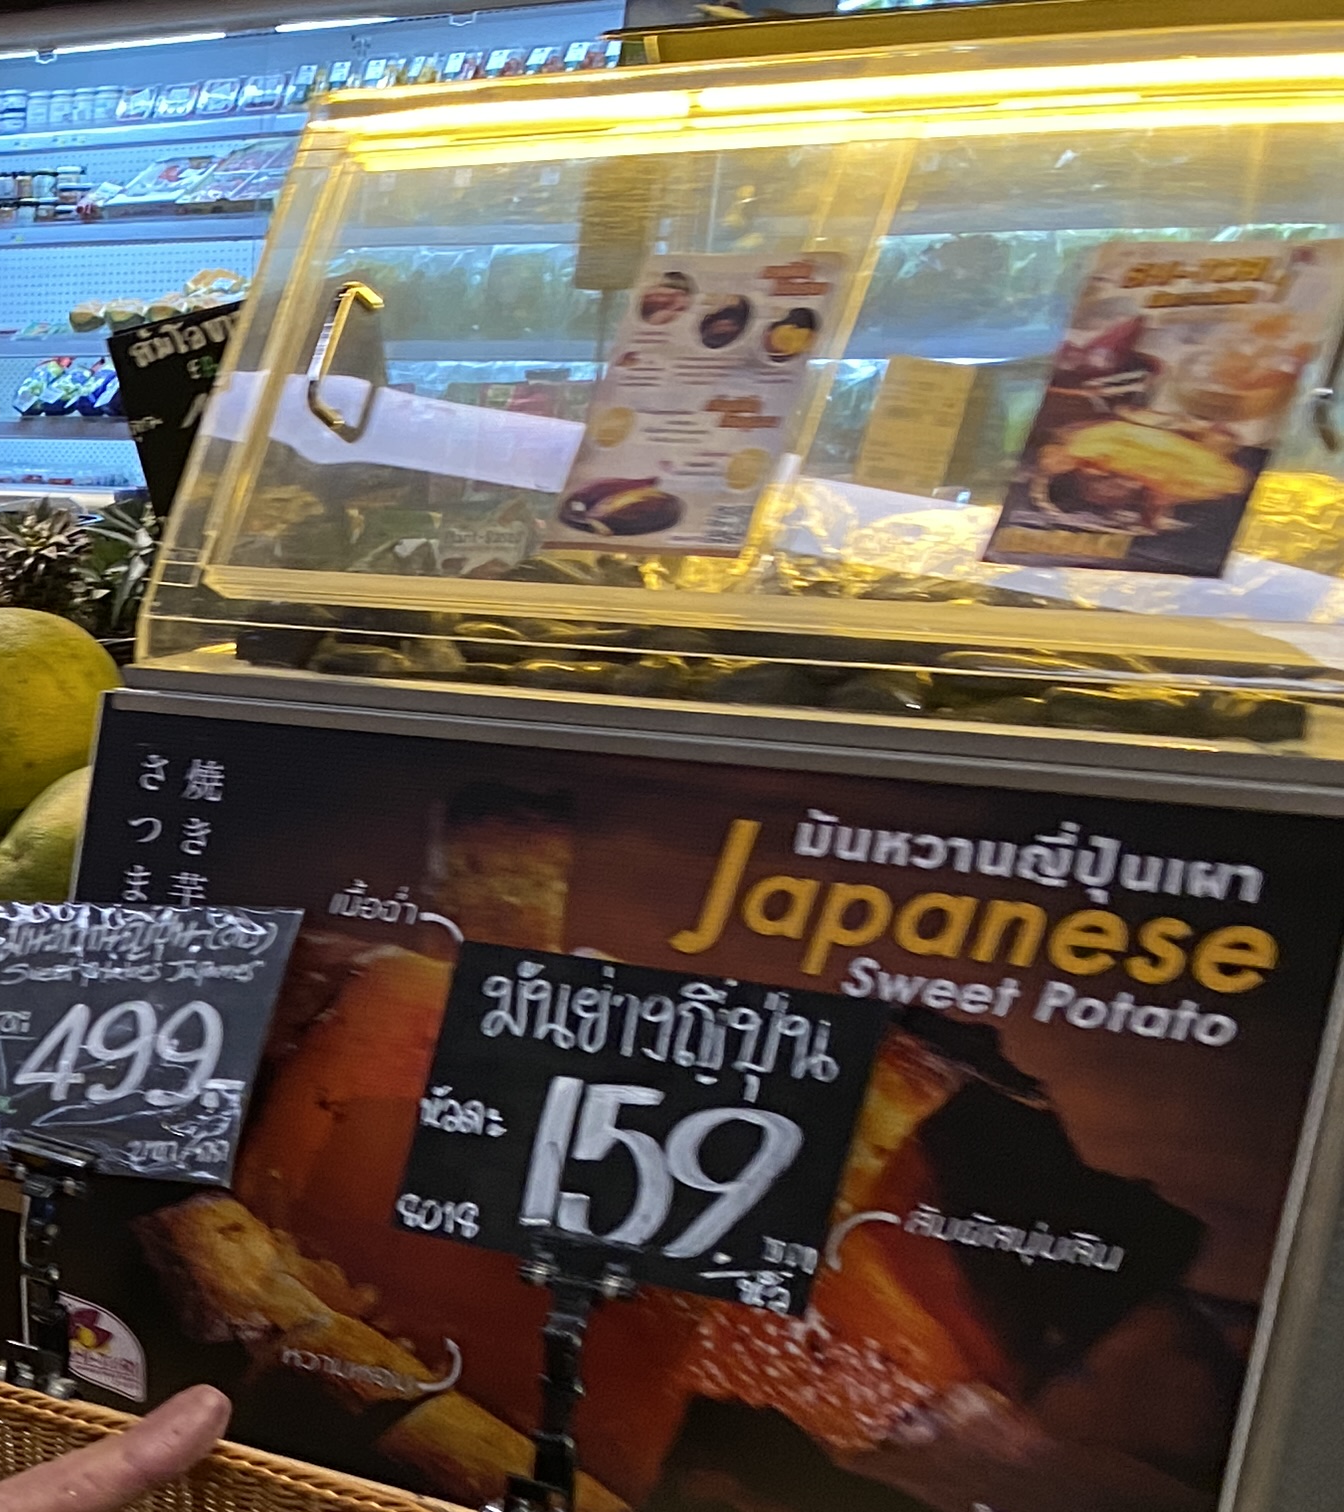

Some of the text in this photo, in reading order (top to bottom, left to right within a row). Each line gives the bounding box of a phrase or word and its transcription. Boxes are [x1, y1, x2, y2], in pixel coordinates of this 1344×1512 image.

[792, 808, 1266, 904] มันหวานญี่ปุ่นเผา
[668, 818, 1281, 995] Japanese
[840, 957, 1239, 1048] Sweet Potato
